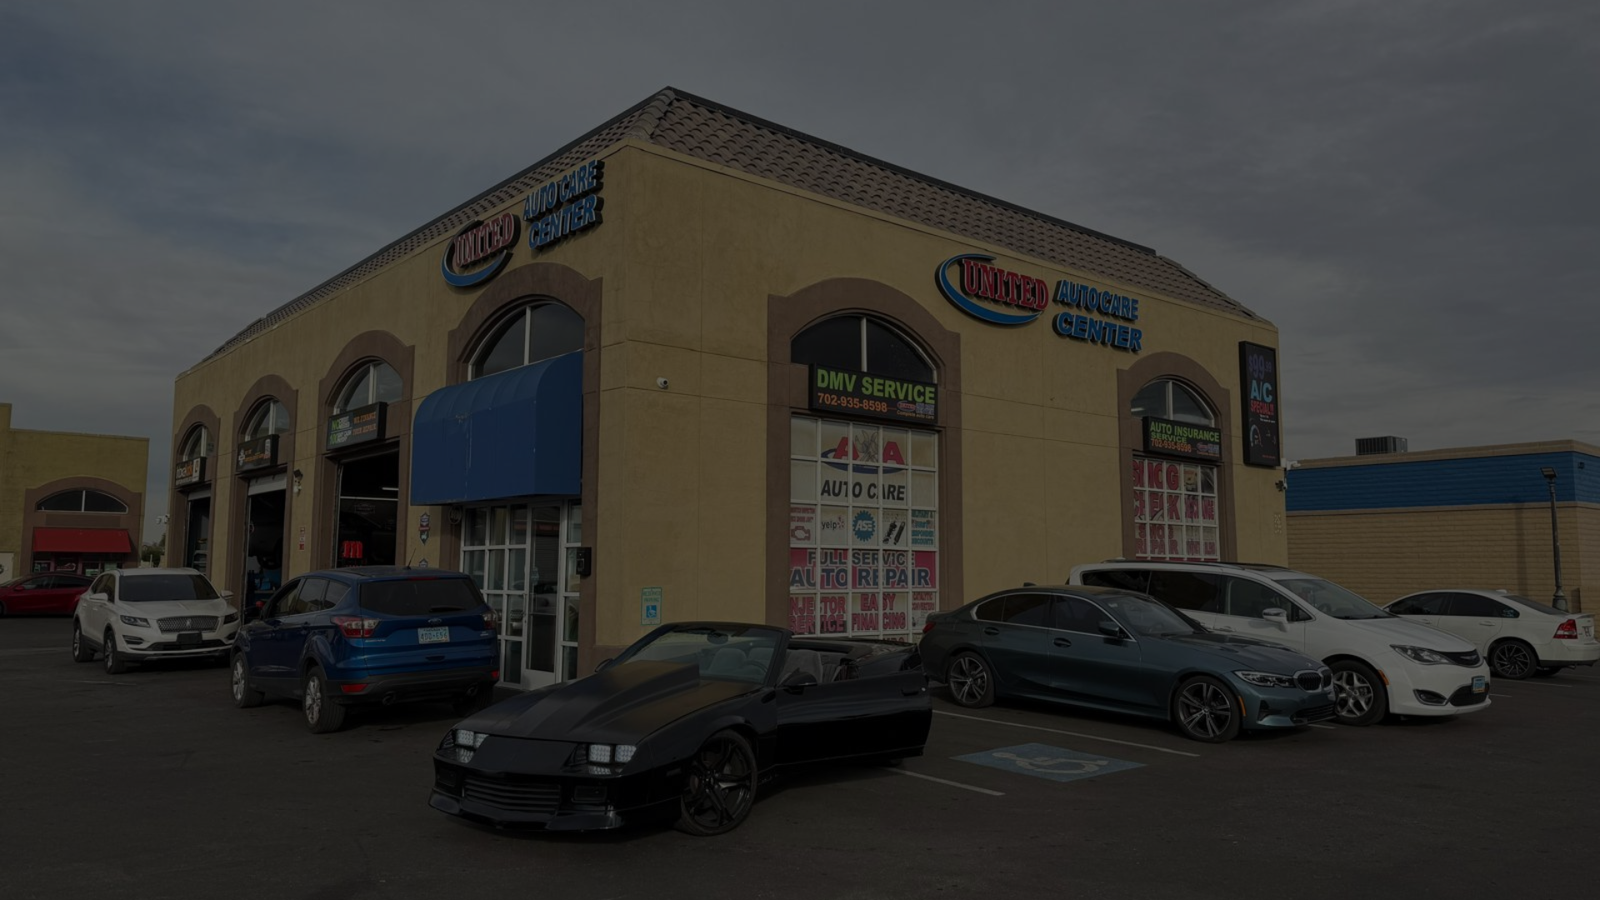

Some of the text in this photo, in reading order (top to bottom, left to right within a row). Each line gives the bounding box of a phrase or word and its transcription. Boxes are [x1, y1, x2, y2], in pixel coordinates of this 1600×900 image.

[523, 159, 600, 220] AUTO CARE
[528, 193, 601, 250] CENTER
[453, 211, 515, 268] UNITED
[962, 258, 1050, 312] UNITED
[1057, 279, 1140, 321] AUTO CARE
[1056, 311, 1143, 351] CENTER
[816, 368, 936, 405] DMV SERVICE
[1250, 379, 1273, 403] A/C
[817, 392, 888, 413] 702-935-8598
[1150, 421, 1220, 442] AUTO INSURANCE
[1151, 432, 1188, 443] SERVICE
[820, 479, 863, 498] AUTO
[821, 520, 837, 530] yelp
[855, 519, 873, 531] ASE
[807, 551, 848, 566] FULL
[790, 567, 931, 588] AUTO REPAIR
[789, 596, 846, 615] NJETOR
